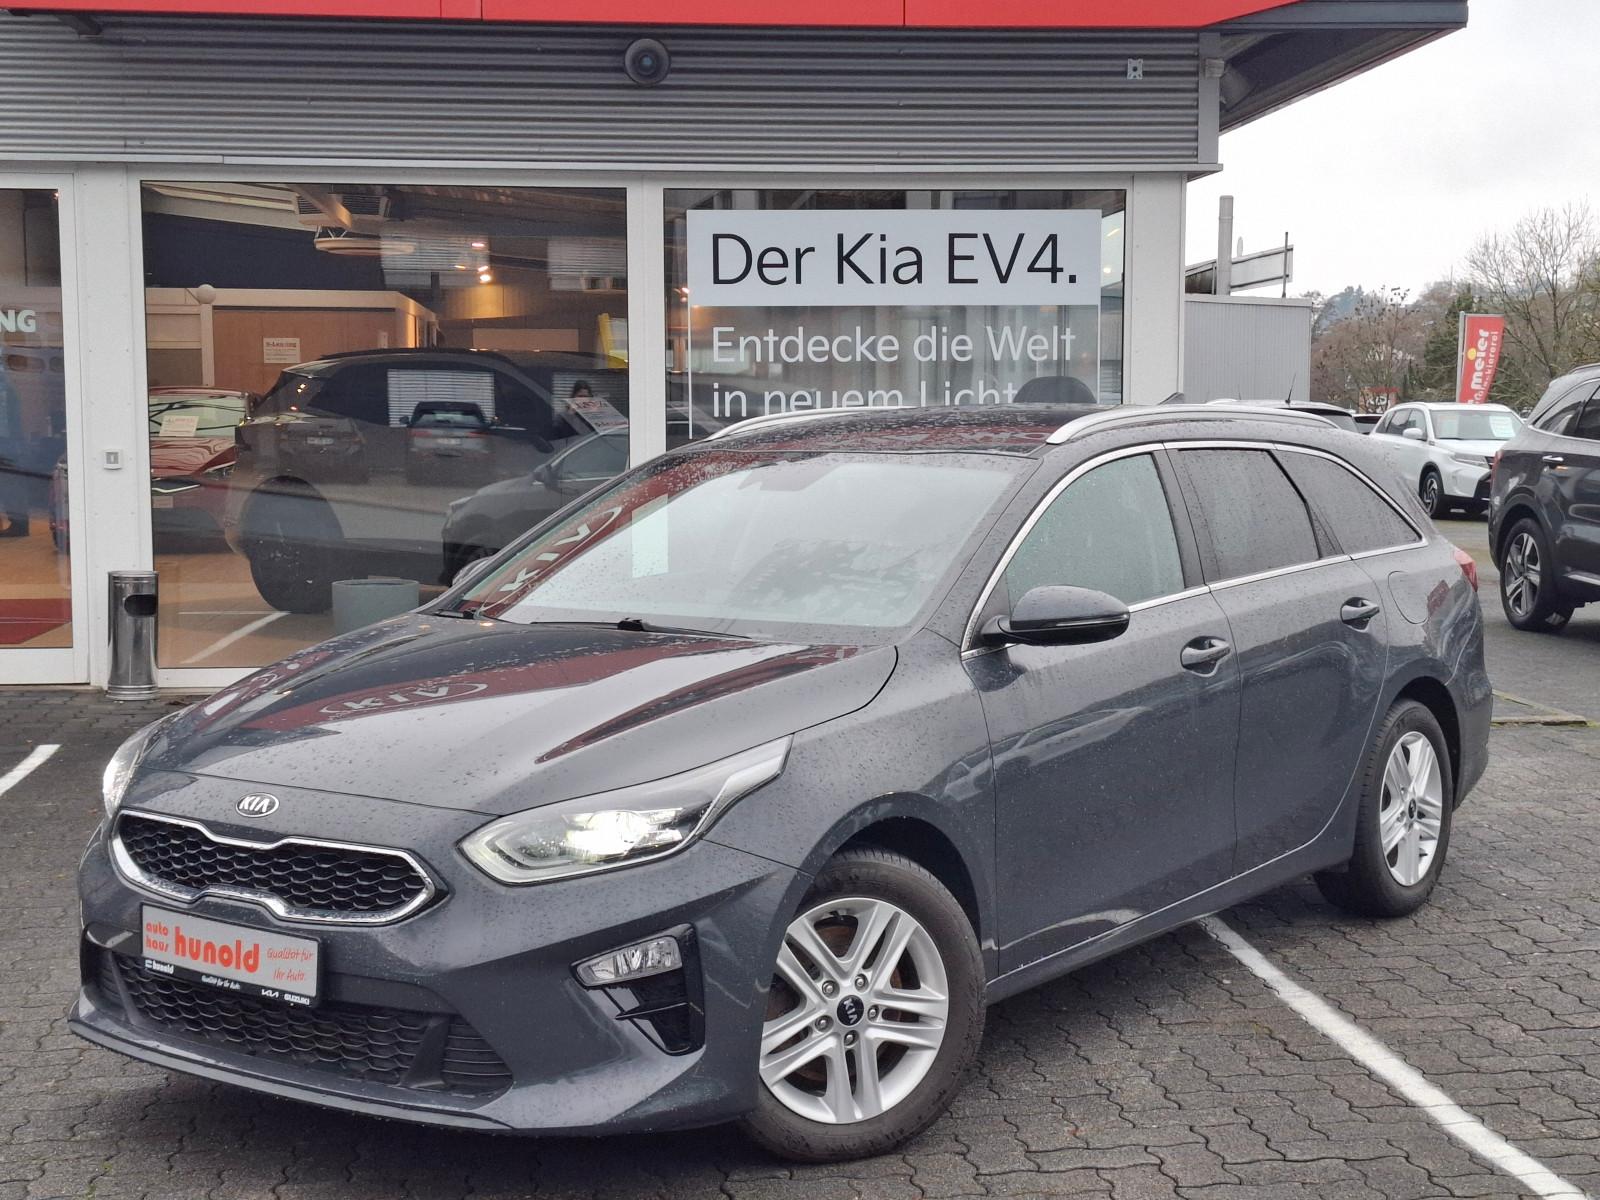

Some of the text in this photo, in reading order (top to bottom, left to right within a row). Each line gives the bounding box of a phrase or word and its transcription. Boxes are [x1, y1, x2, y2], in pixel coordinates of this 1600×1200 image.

[712, 232, 1078, 286] Der Kia EV4.
[712, 325, 1076, 363] Entdecke die Welt
[712, 382, 746, 418] in
[238, 795, 272, 814] KIA
[145, 921, 169, 937] auto
[174, 926, 260, 974] hunold
[843, 997, 859, 1024] KIA
